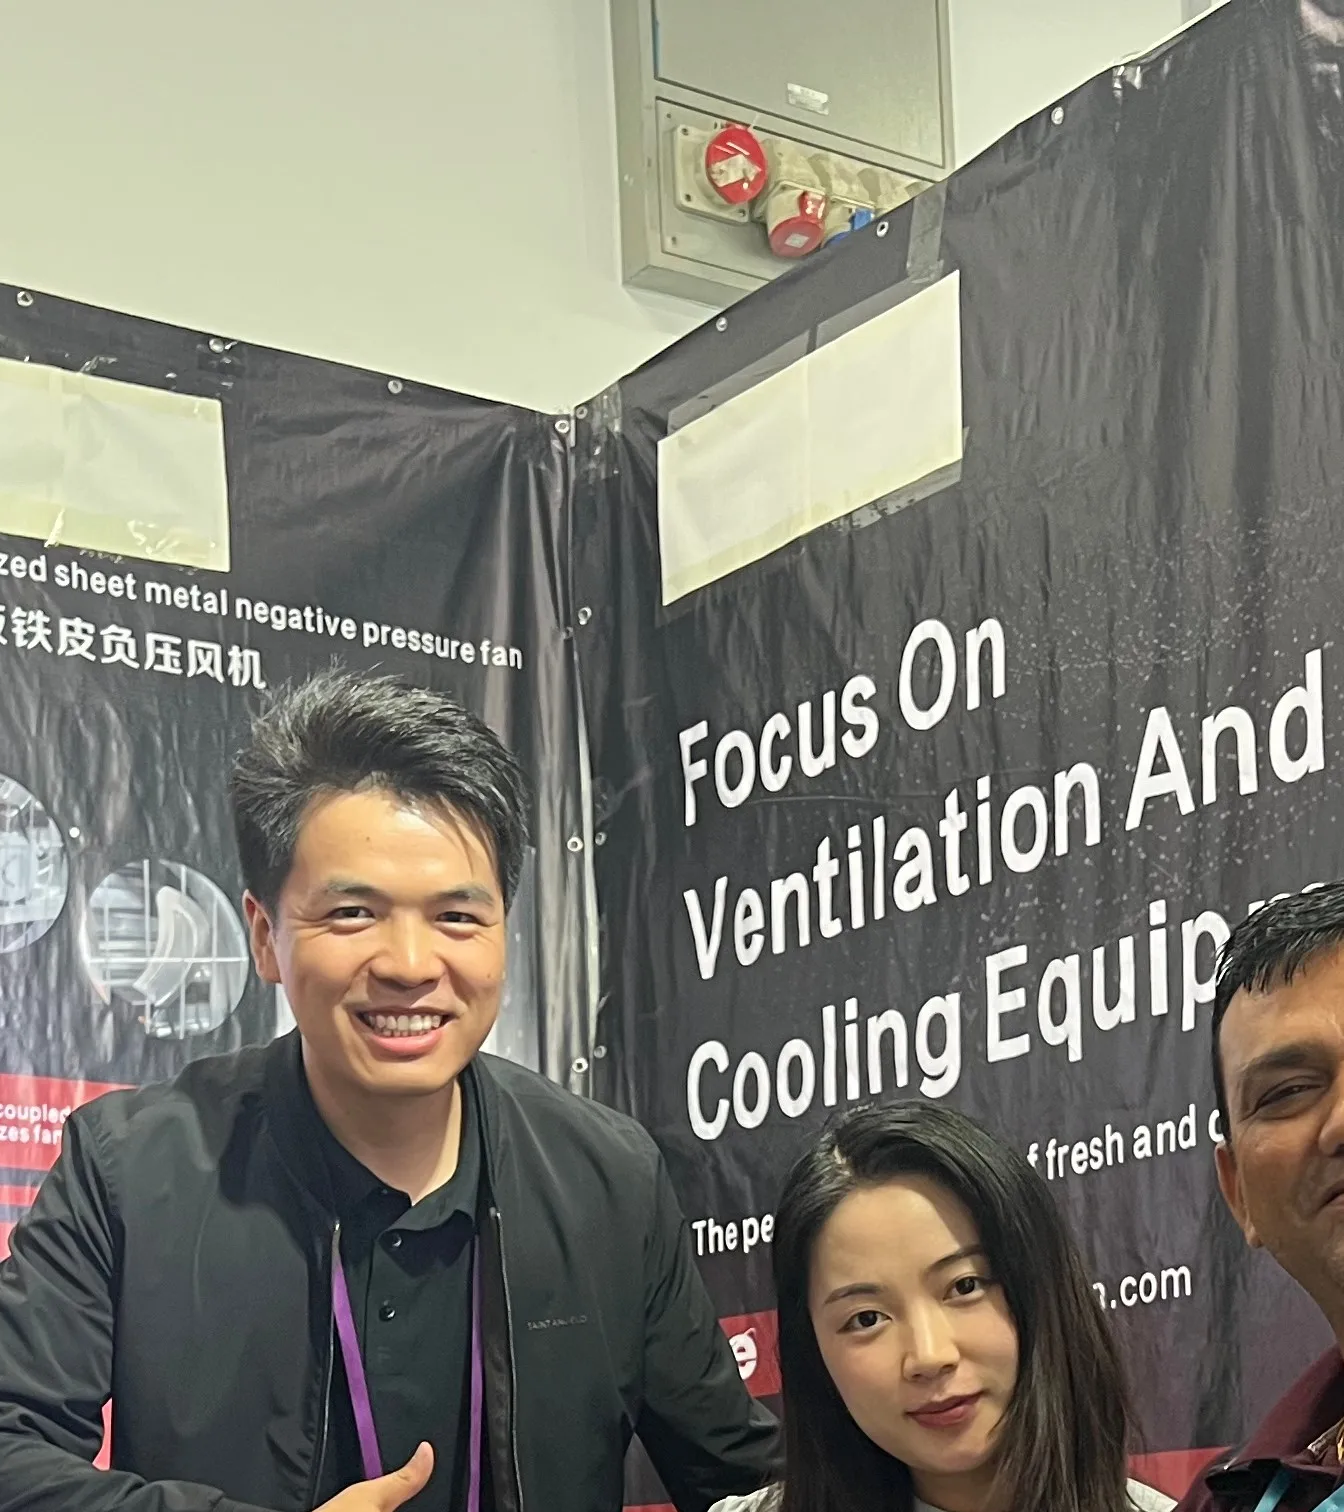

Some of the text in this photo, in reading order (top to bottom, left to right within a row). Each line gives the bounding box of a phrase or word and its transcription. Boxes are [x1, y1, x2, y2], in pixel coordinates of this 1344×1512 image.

[54, 552, 137, 602] sheet
[144, 577, 229, 617] metal
[235, 597, 358, 642] negative
[362, 621, 476, 665] pressure
[479, 640, 524, 670] fan
[677, 616, 1008, 827] Focus On
[681, 647, 1325, 981] Ventilation And
[685, 987, 962, 1142] Cooling
[691, 1217, 739, 1256] The
[1045, 1124, 1124, 1180] fresh
[1132, 1103, 1197, 1160] and
